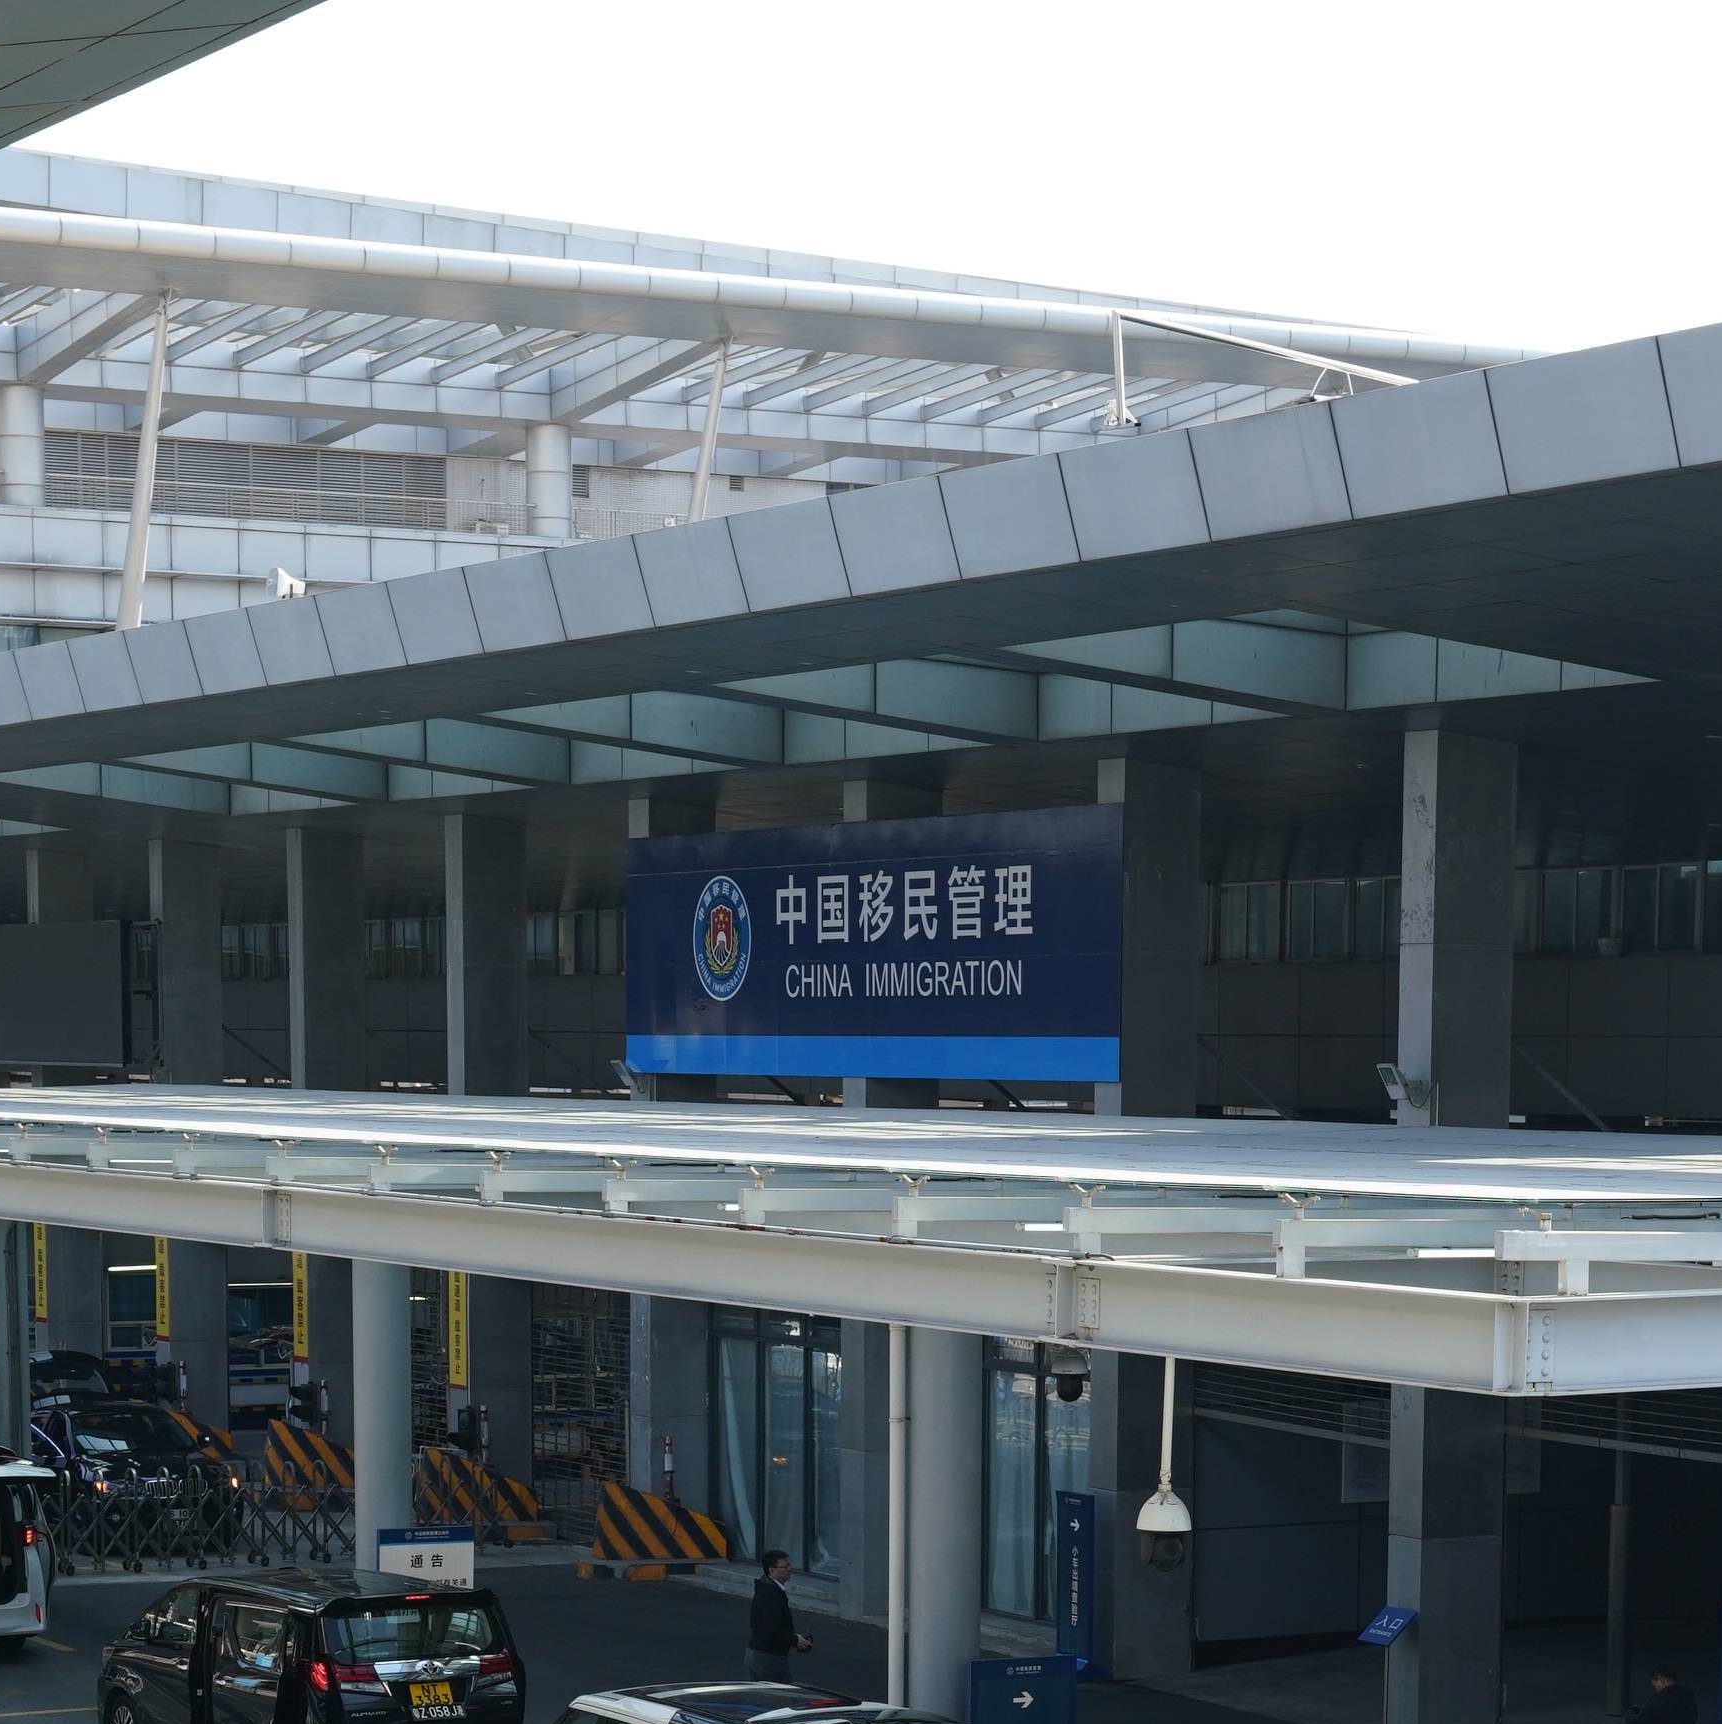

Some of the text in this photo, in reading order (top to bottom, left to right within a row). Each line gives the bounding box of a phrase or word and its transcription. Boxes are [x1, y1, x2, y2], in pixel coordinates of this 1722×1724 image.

[776, 864, 1034, 945] 中国移民管理
[712, 953, 747, 993] IMMIGRATION
[785, 959, 1023, 998] CHINA IMMIGRATION
[410, 1554, 444, 1569] 通告
[1375, 1615, 1404, 1630] 入口
[420, 1684, 438, 1696] NT
[415, 1694, 451, 1705] 3383
